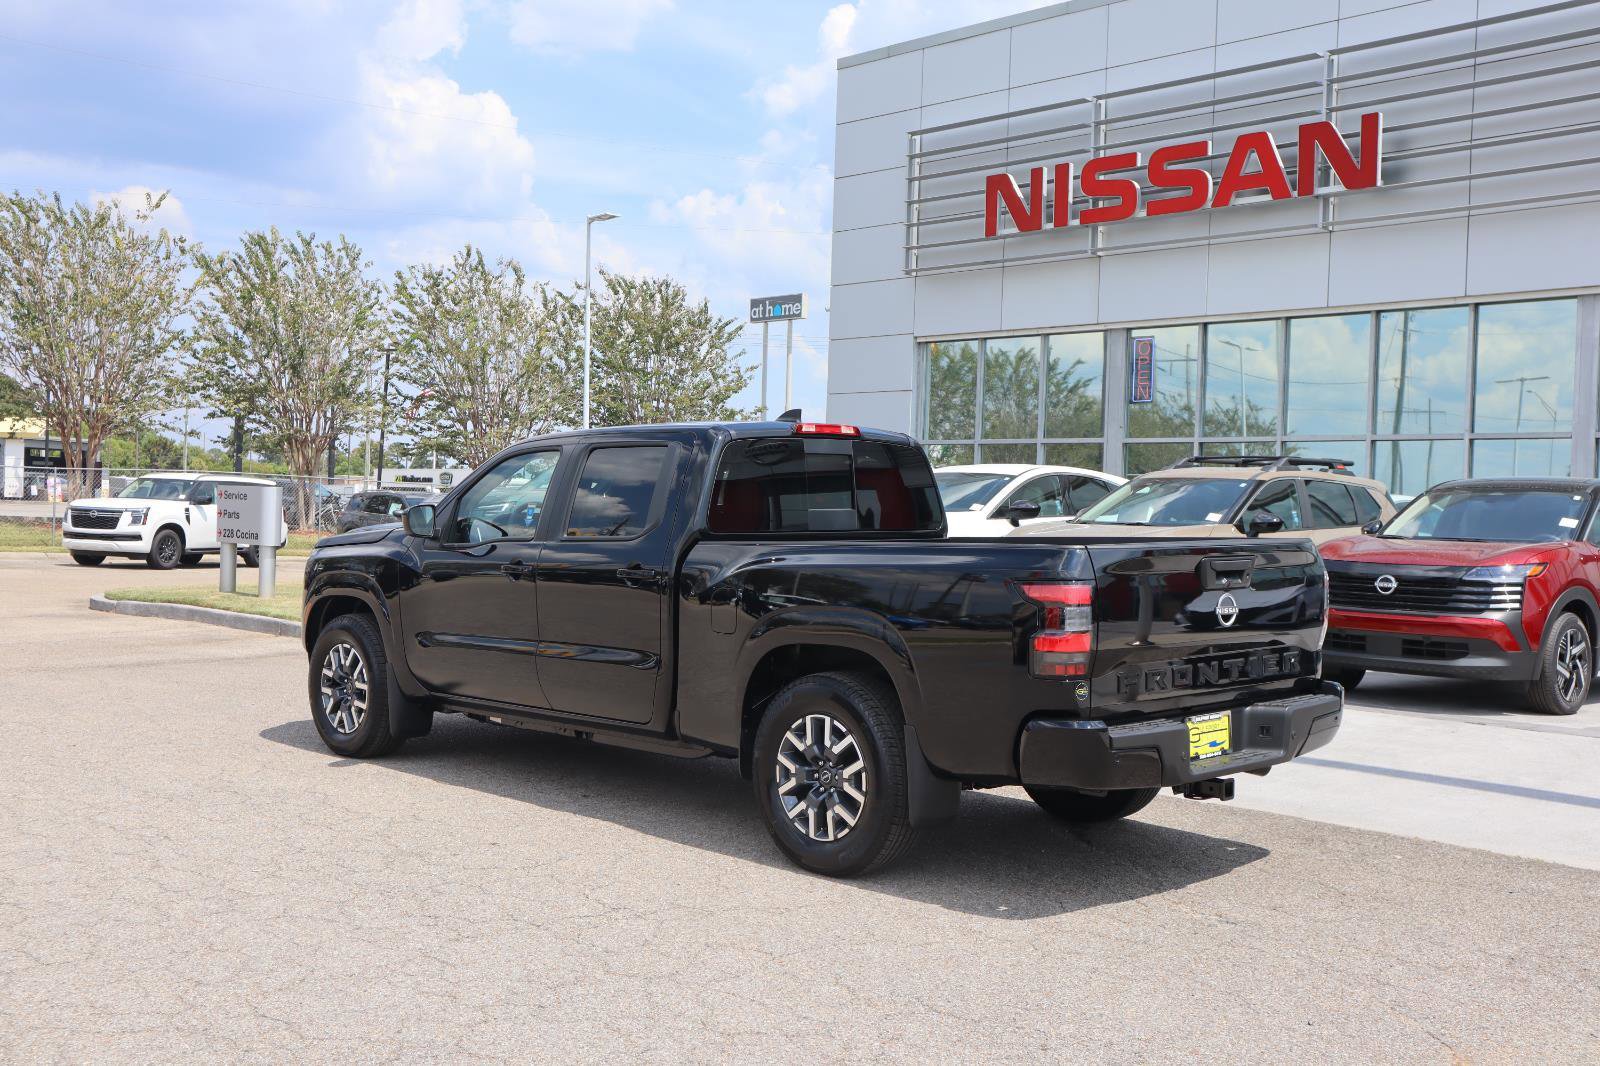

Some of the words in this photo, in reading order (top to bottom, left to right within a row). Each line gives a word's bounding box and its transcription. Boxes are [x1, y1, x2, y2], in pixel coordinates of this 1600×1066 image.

[985, 112, 1383, 238] NISSAN
[1137, 341, 1151, 400] OPEN
[223, 490, 248, 501] Service
[223, 509, 240, 520] Parts
[223, 528, 235, 539] 228
[235, 529, 259, 540] Cocina
[1216, 606, 1239, 615] NISSAN
[1116, 651, 1301, 698] FRONTIER
